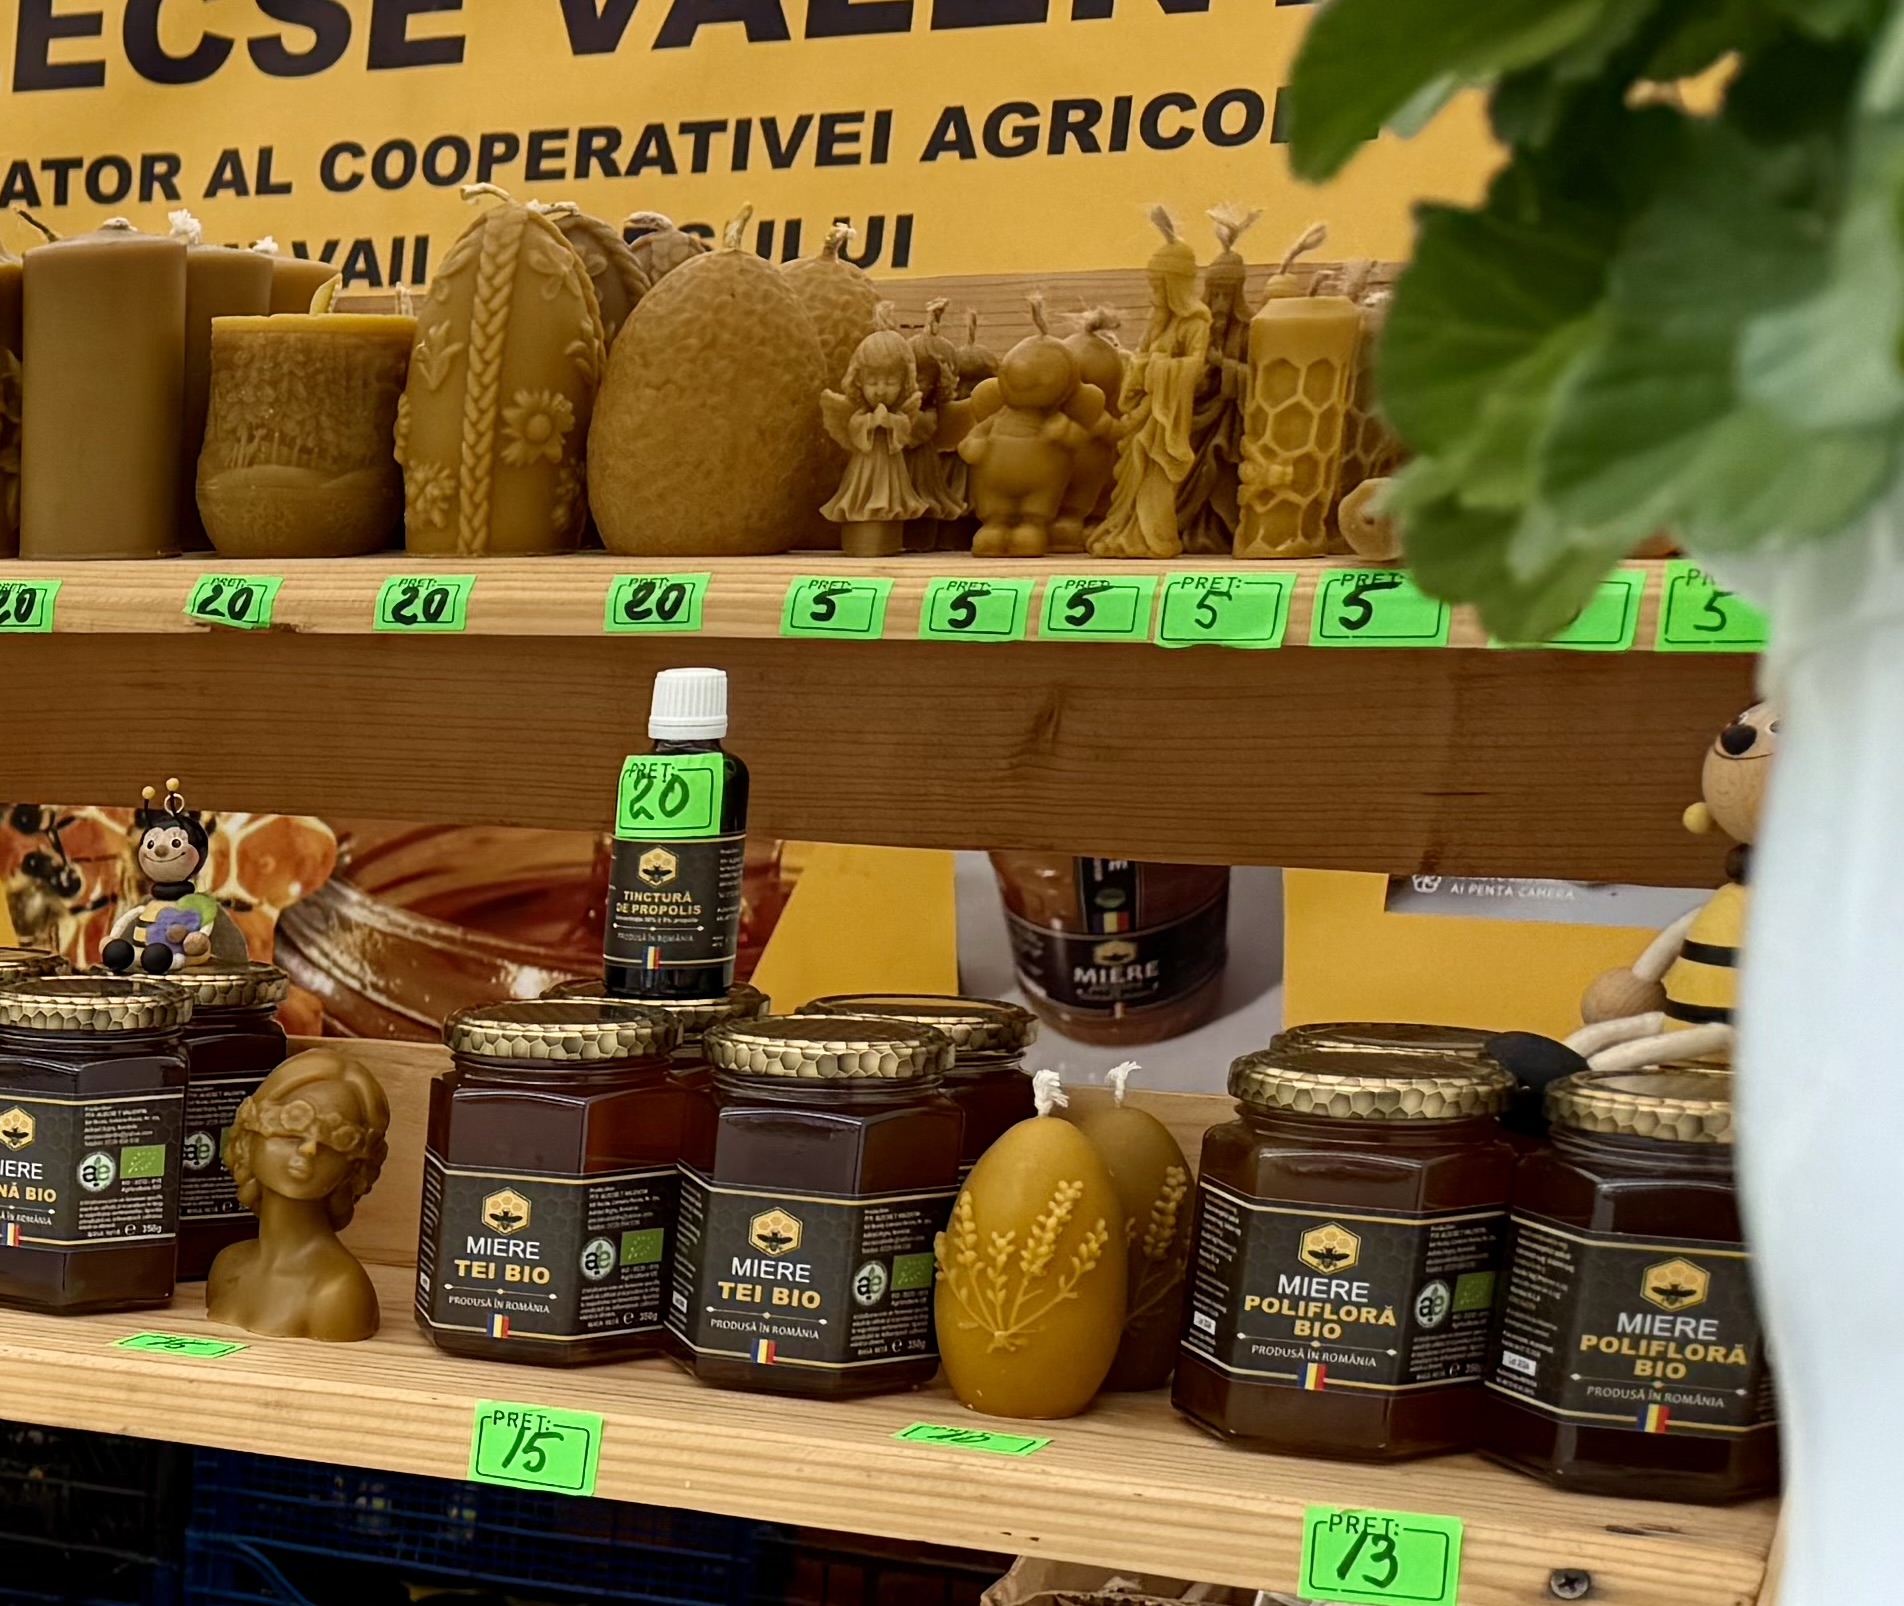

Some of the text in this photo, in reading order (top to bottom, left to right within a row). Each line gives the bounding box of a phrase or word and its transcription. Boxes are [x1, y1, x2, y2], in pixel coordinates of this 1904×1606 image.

[204, 147, 294, 198] AL
[318, 107, 893, 193] COOPERATIVEI
[920, 86, 1379, 162] AGRICO
[197, 585, 253, 619] 20
[392, 587, 450, 626] 20
[624, 581, 685, 621] 20
[810, 588, 852, 621] 5
[947, 589, 992, 629] 5
[1065, 584, 1115, 627] 5
[1194, 590, 1232, 629] 5
[1338, 581, 1403, 630] 5
[1693, 590, 1733, 631] 5
[629, 774, 691, 820] 20
[632, 903, 701, 915] PROPOLIS
[1074, 959, 1159, 984] MIERE
[25, 1186, 57, 1203] BIO
[466, 1236, 541, 1260] MIERE
[454, 1258, 551, 1285] TEI BIO
[732, 1256, 812, 1283] MIERE
[717, 1281, 821, 1310] TEI BIO
[1278, 1274, 1370, 1303] MIERE
[1244, 1295, 1397, 1327] POLIFLORĂ
[1617, 1312, 1718, 1341] MIERE
[1293, 1319, 1342, 1340] BIO
[1579, 1334, 1747, 1366] POLIFLORĂ
[1633, 1359, 1686, 1380] BIO
[501, 1427, 563, 1476] 15
[1337, 1533, 1399, 1590] 13
